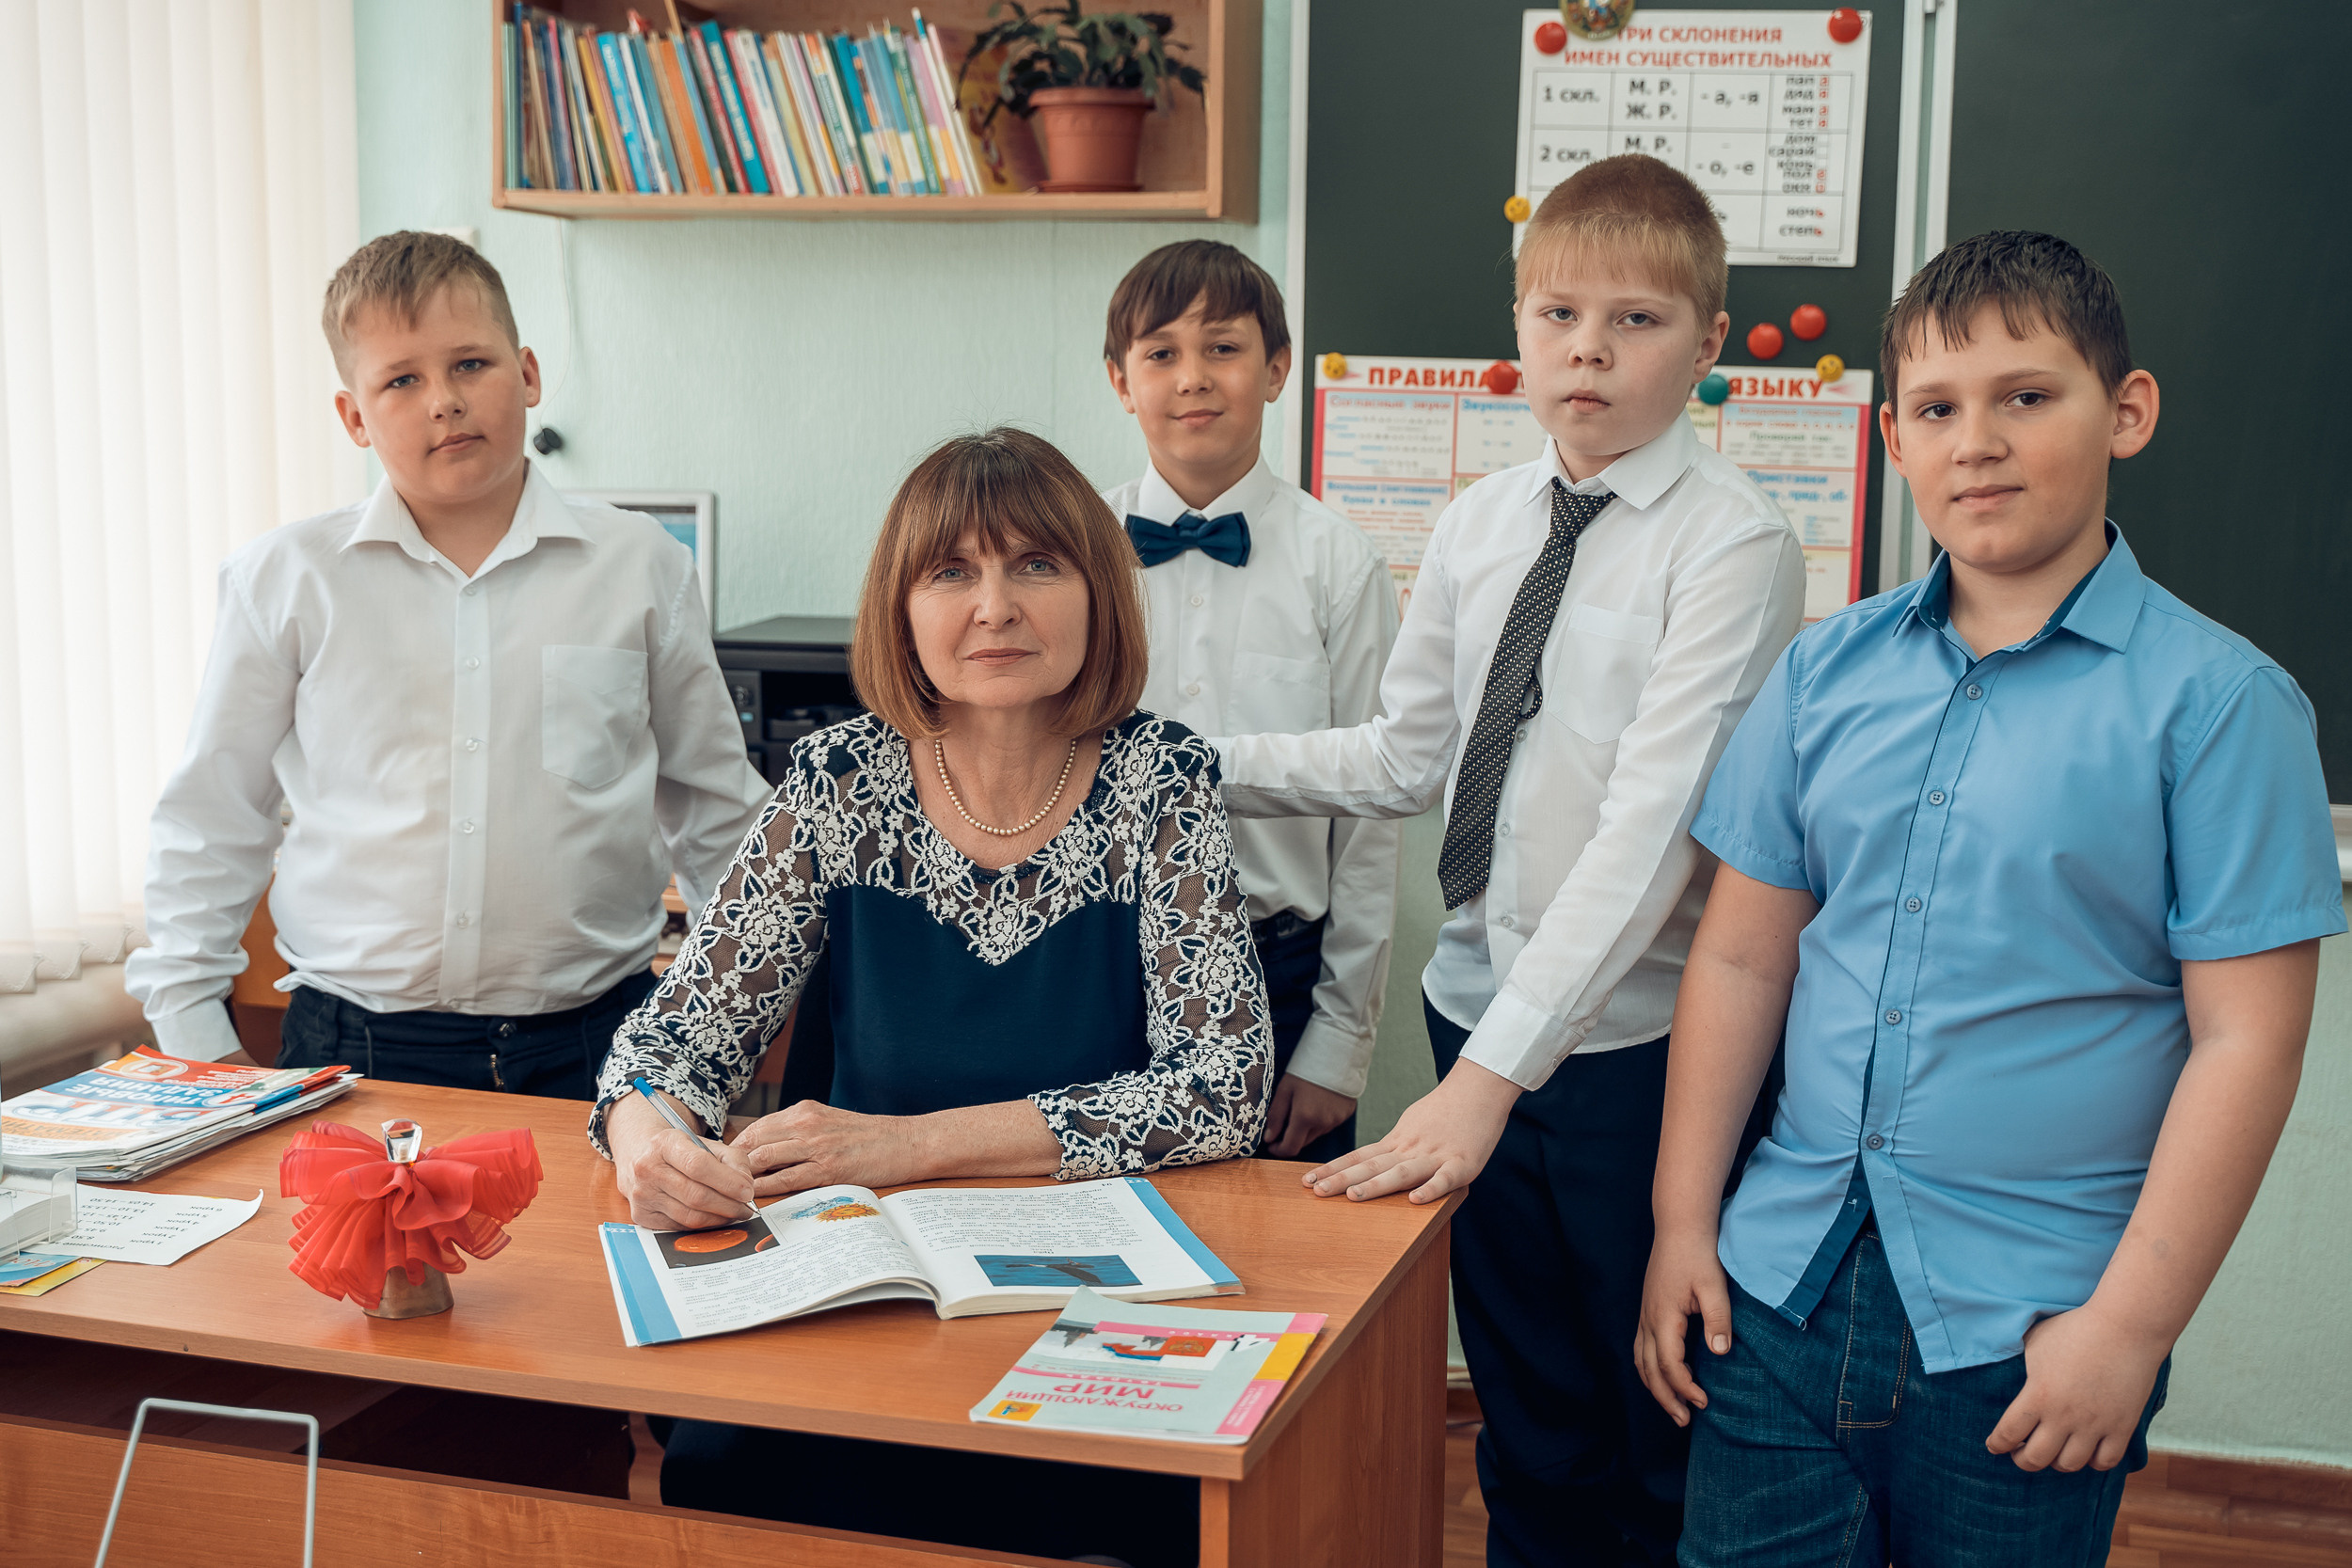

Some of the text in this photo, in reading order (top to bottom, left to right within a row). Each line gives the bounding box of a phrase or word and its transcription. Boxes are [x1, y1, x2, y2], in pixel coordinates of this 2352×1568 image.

[1659, 26, 1783, 43] СКЛОНЕНИЯ
[1565, 50, 1832, 69] ИМЕН СУЩЕСТВИТЕЛЬНЫХ
[1543, 87, 1599, 103] 1 скл.
[1629, 79, 1677, 96] М. Р.
[1626, 104, 1677, 120] Ж. Р.
[1625, 136, 1672, 152] М. Р.
[1540, 145, 1550, 162] 2
[1729, 377, 1823, 398] ЯЗЫКУ
[65, 1083, 201, 1105] ТИПОВЫЕ
[91, 1076, 224, 1098] ЗАДАНИЯ
[11, 1100, 217, 1128] ВПР
[1231, 1334, 1270, 1352] 4
[1054, 1383, 1155, 1400] МИР
[1005, 1389, 1184, 1413] ОКРУЖАЮЩИЙ
